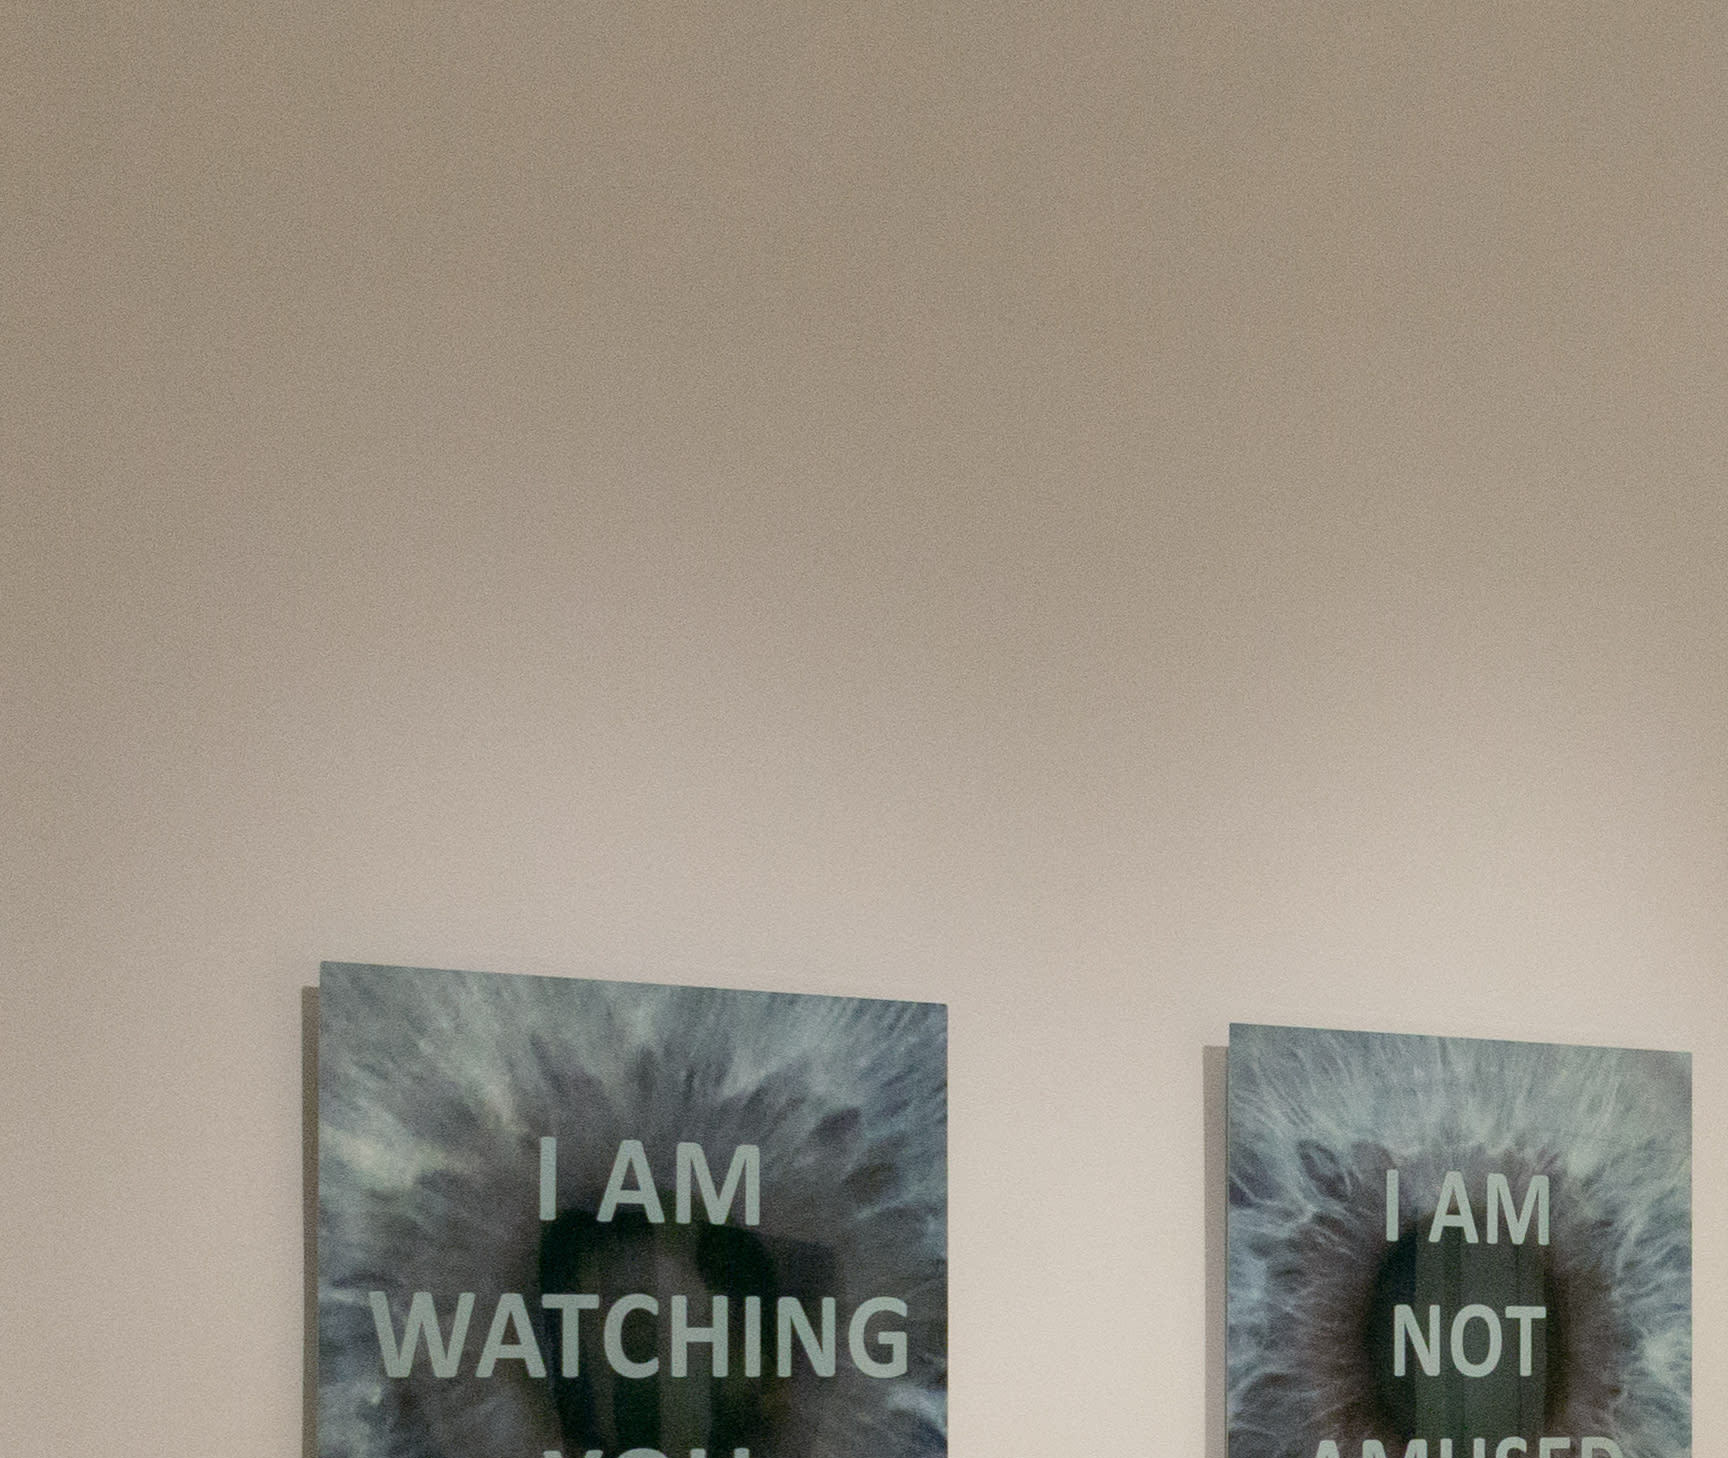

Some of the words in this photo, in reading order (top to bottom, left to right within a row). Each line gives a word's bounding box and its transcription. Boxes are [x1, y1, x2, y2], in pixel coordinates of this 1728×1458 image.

[538, 1136, 557, 1222] I
[597, 1139, 762, 1227] AM
[1385, 1168, 1400, 1243] I
[1428, 1170, 1551, 1246] AM
[369, 1290, 909, 1380] WATCHING
[1392, 1302, 1547, 1379] NOT
